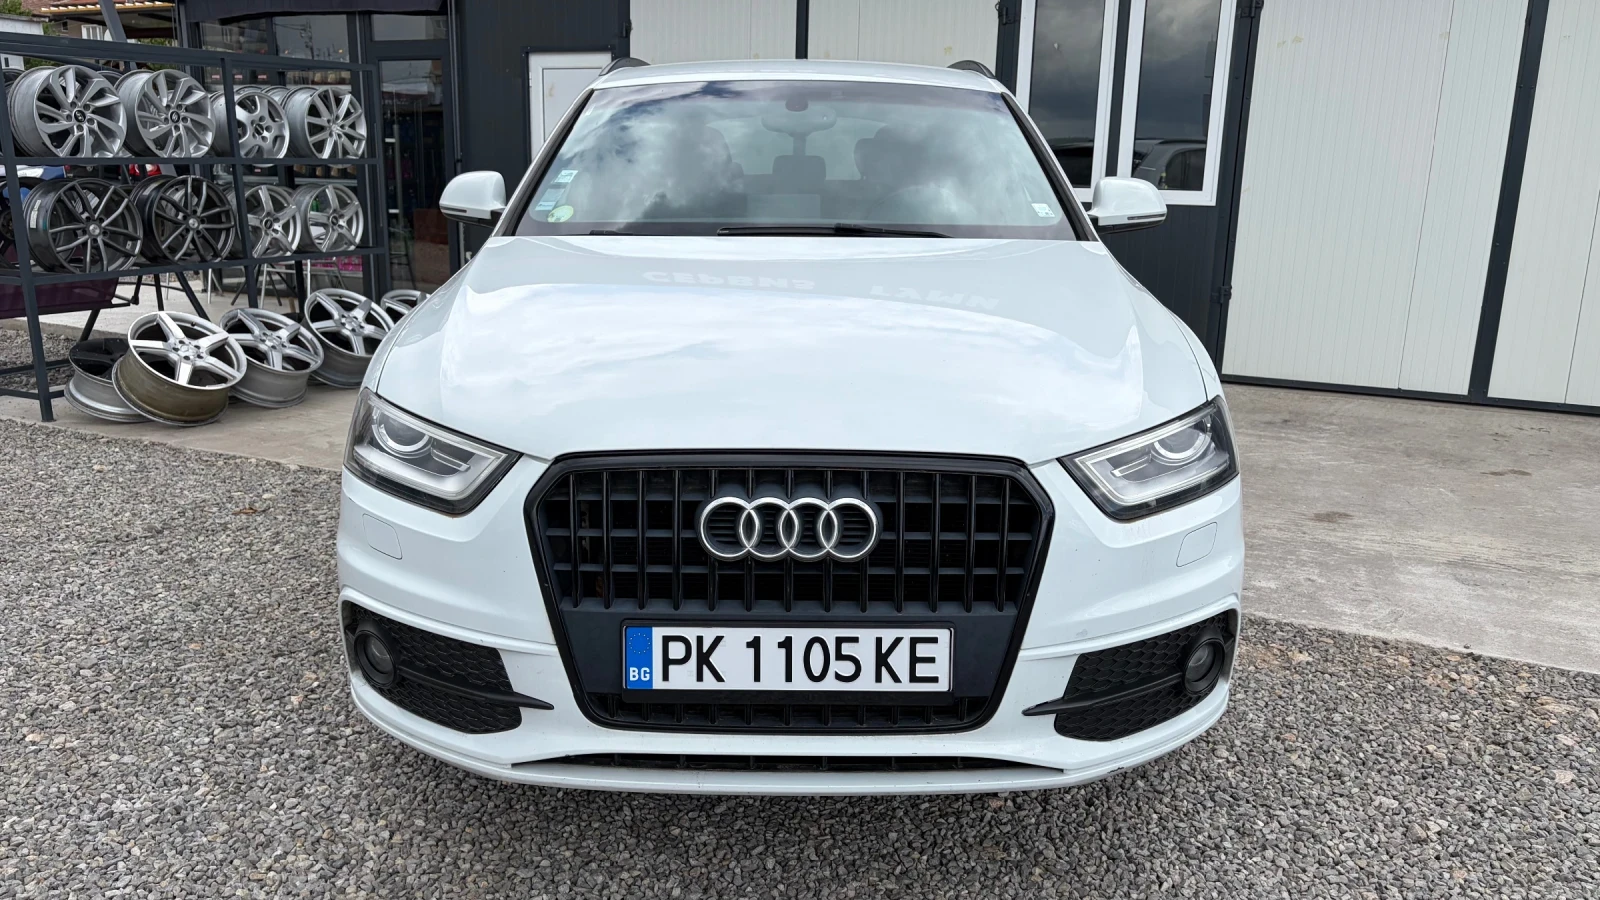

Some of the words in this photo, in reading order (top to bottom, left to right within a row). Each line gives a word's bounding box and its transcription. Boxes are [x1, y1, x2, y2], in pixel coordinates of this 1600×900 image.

[629, 667, 651, 681] BG
[661, 635, 726, 683] PK
[746, 635, 862, 684] 1105
[874, 636, 940, 684] KE
